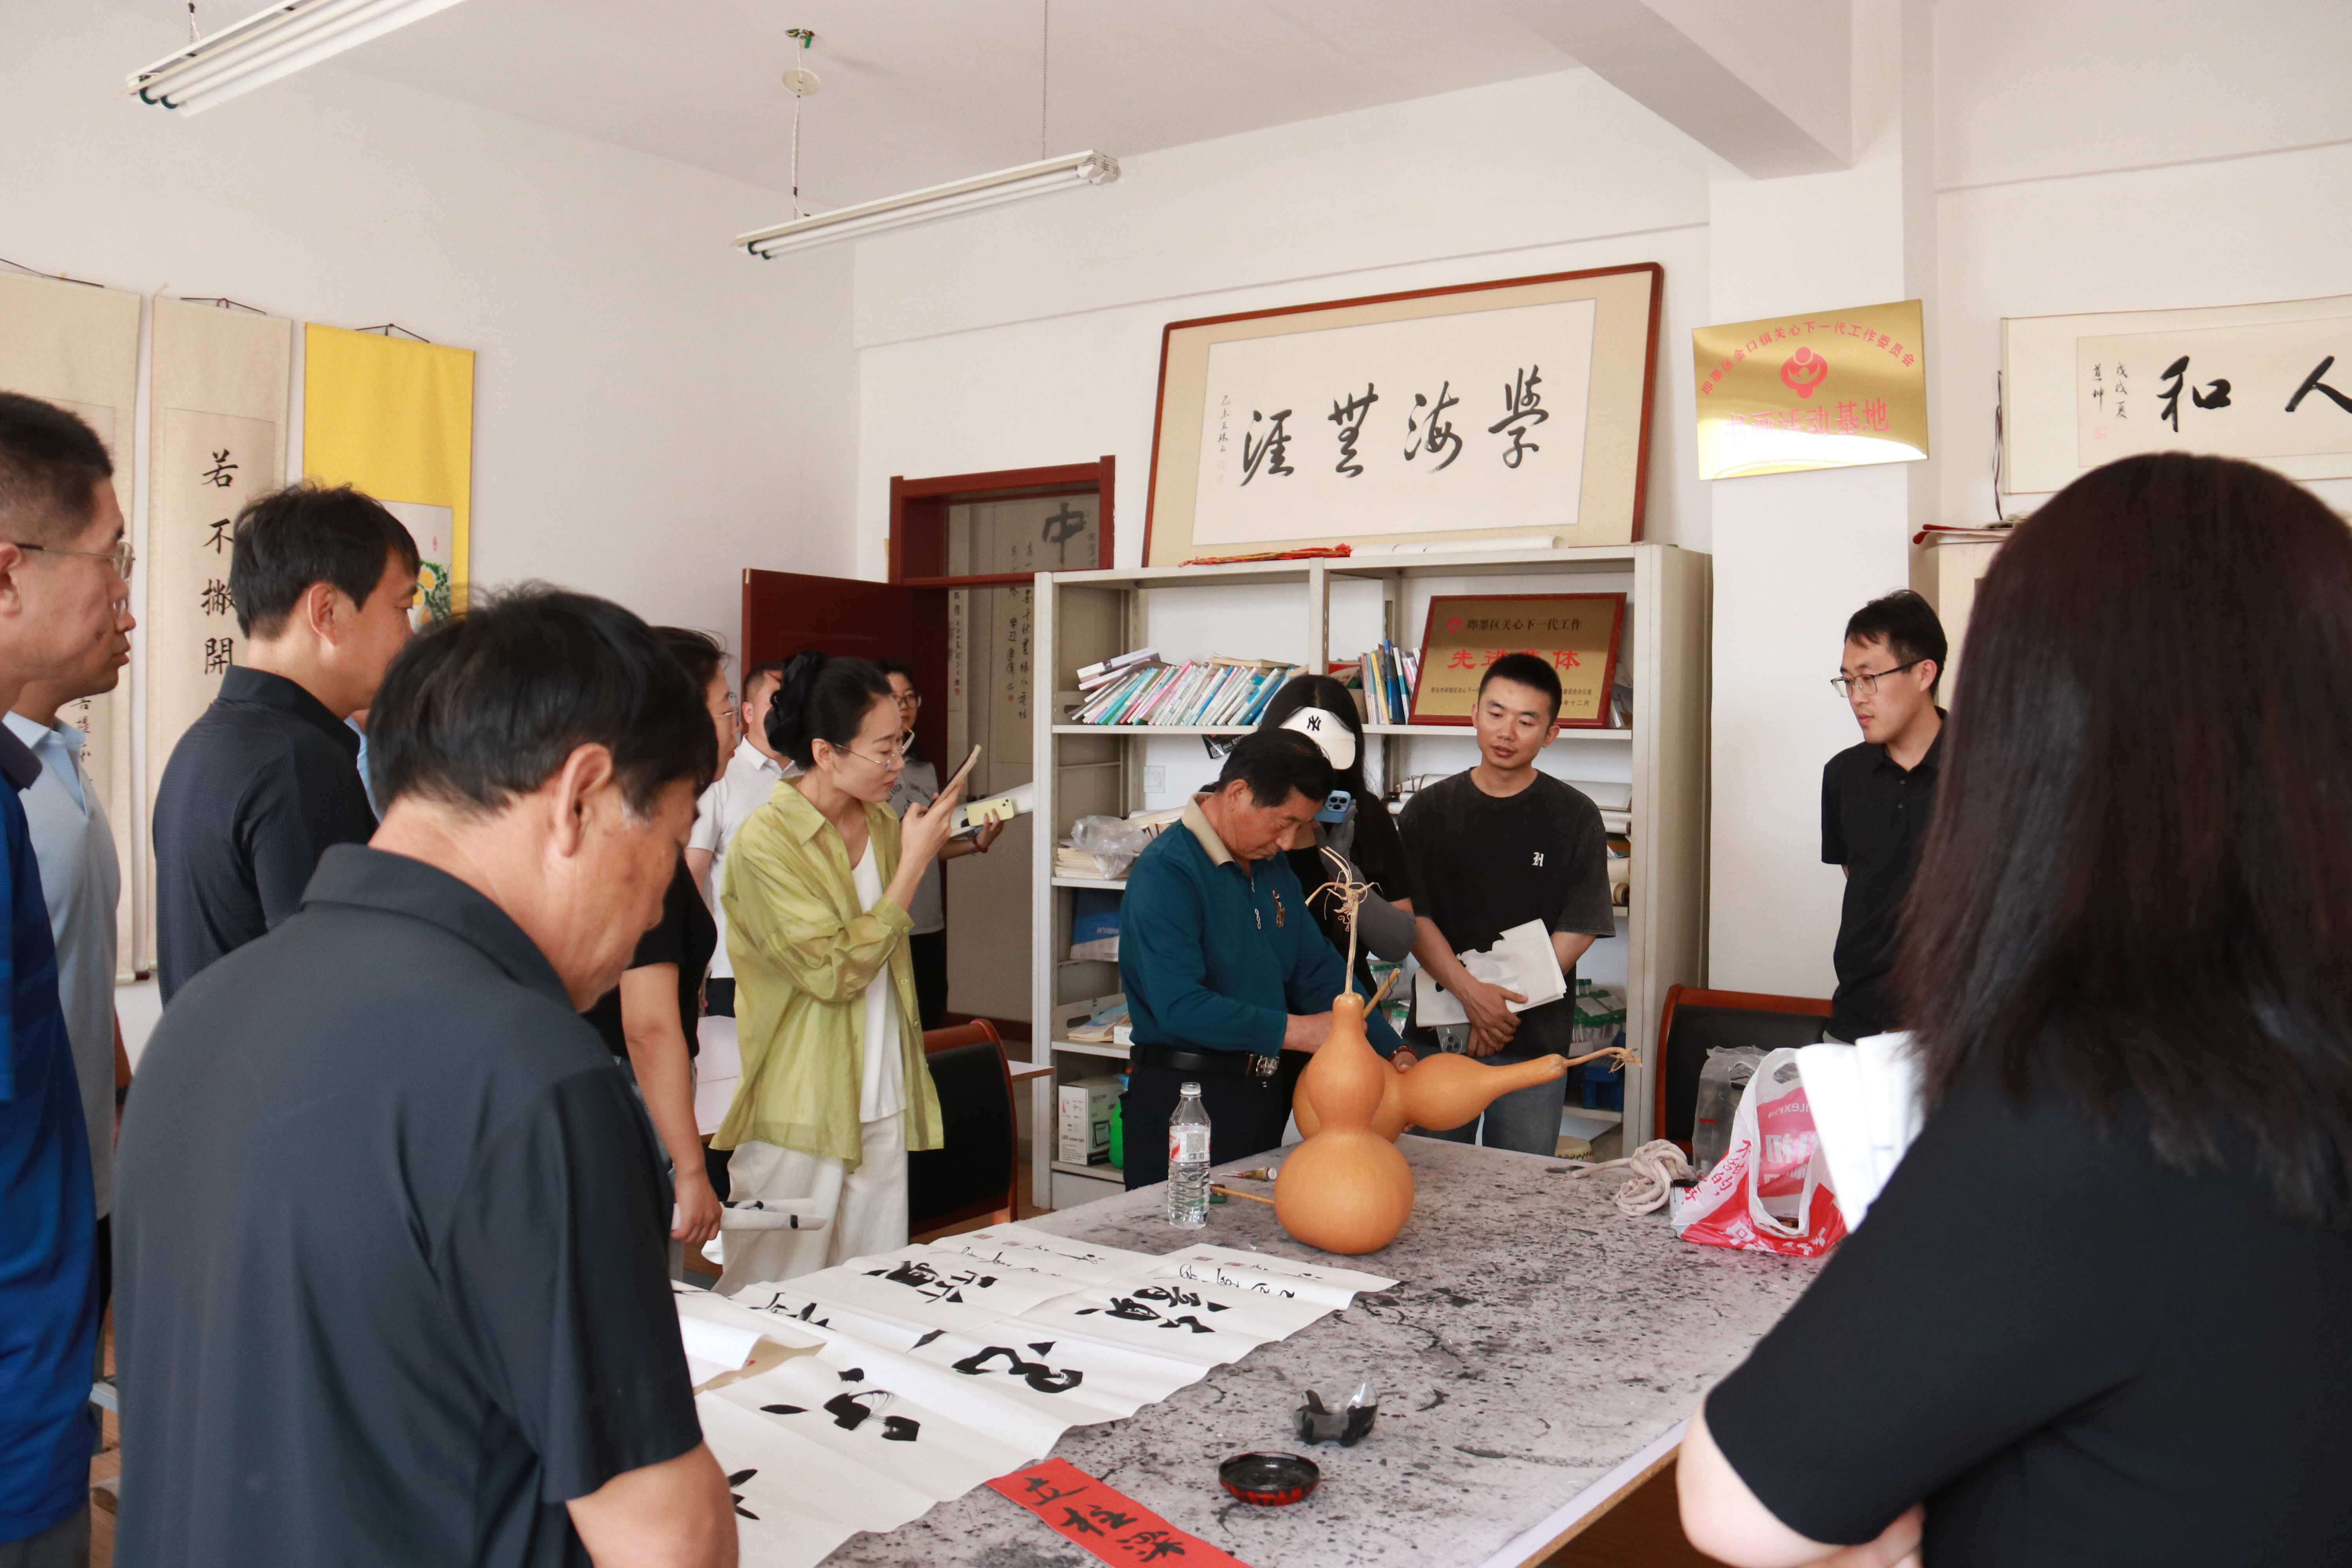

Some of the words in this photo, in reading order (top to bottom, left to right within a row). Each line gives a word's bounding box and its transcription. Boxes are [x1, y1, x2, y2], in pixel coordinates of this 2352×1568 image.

[1467, 618, 1582, 630] 即墨区关心下一代工作
